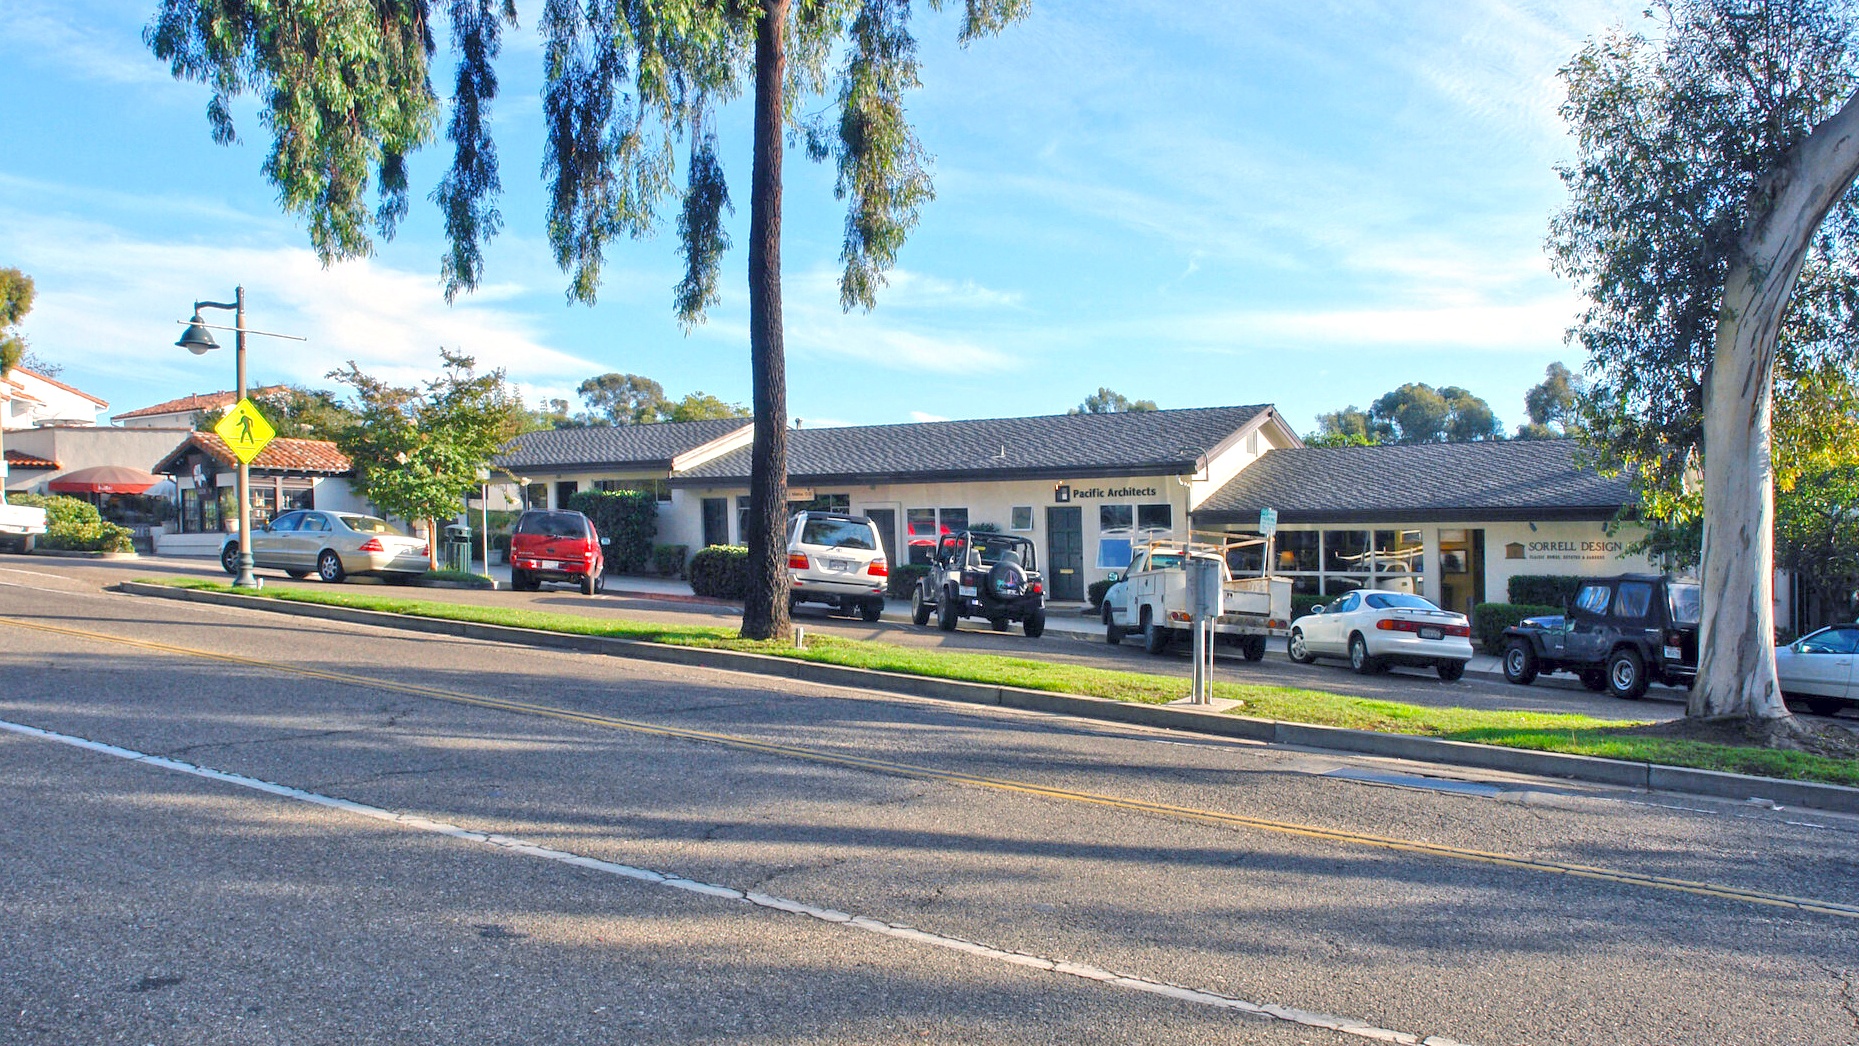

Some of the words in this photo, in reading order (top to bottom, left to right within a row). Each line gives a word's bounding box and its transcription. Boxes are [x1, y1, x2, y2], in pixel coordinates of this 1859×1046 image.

[1073, 488, 1104, 498] Pacific
[1107, 487, 1156, 497] Architects
[1528, 541, 1576, 551] SORRELL
[1581, 541, 1622, 551] DESIGN
